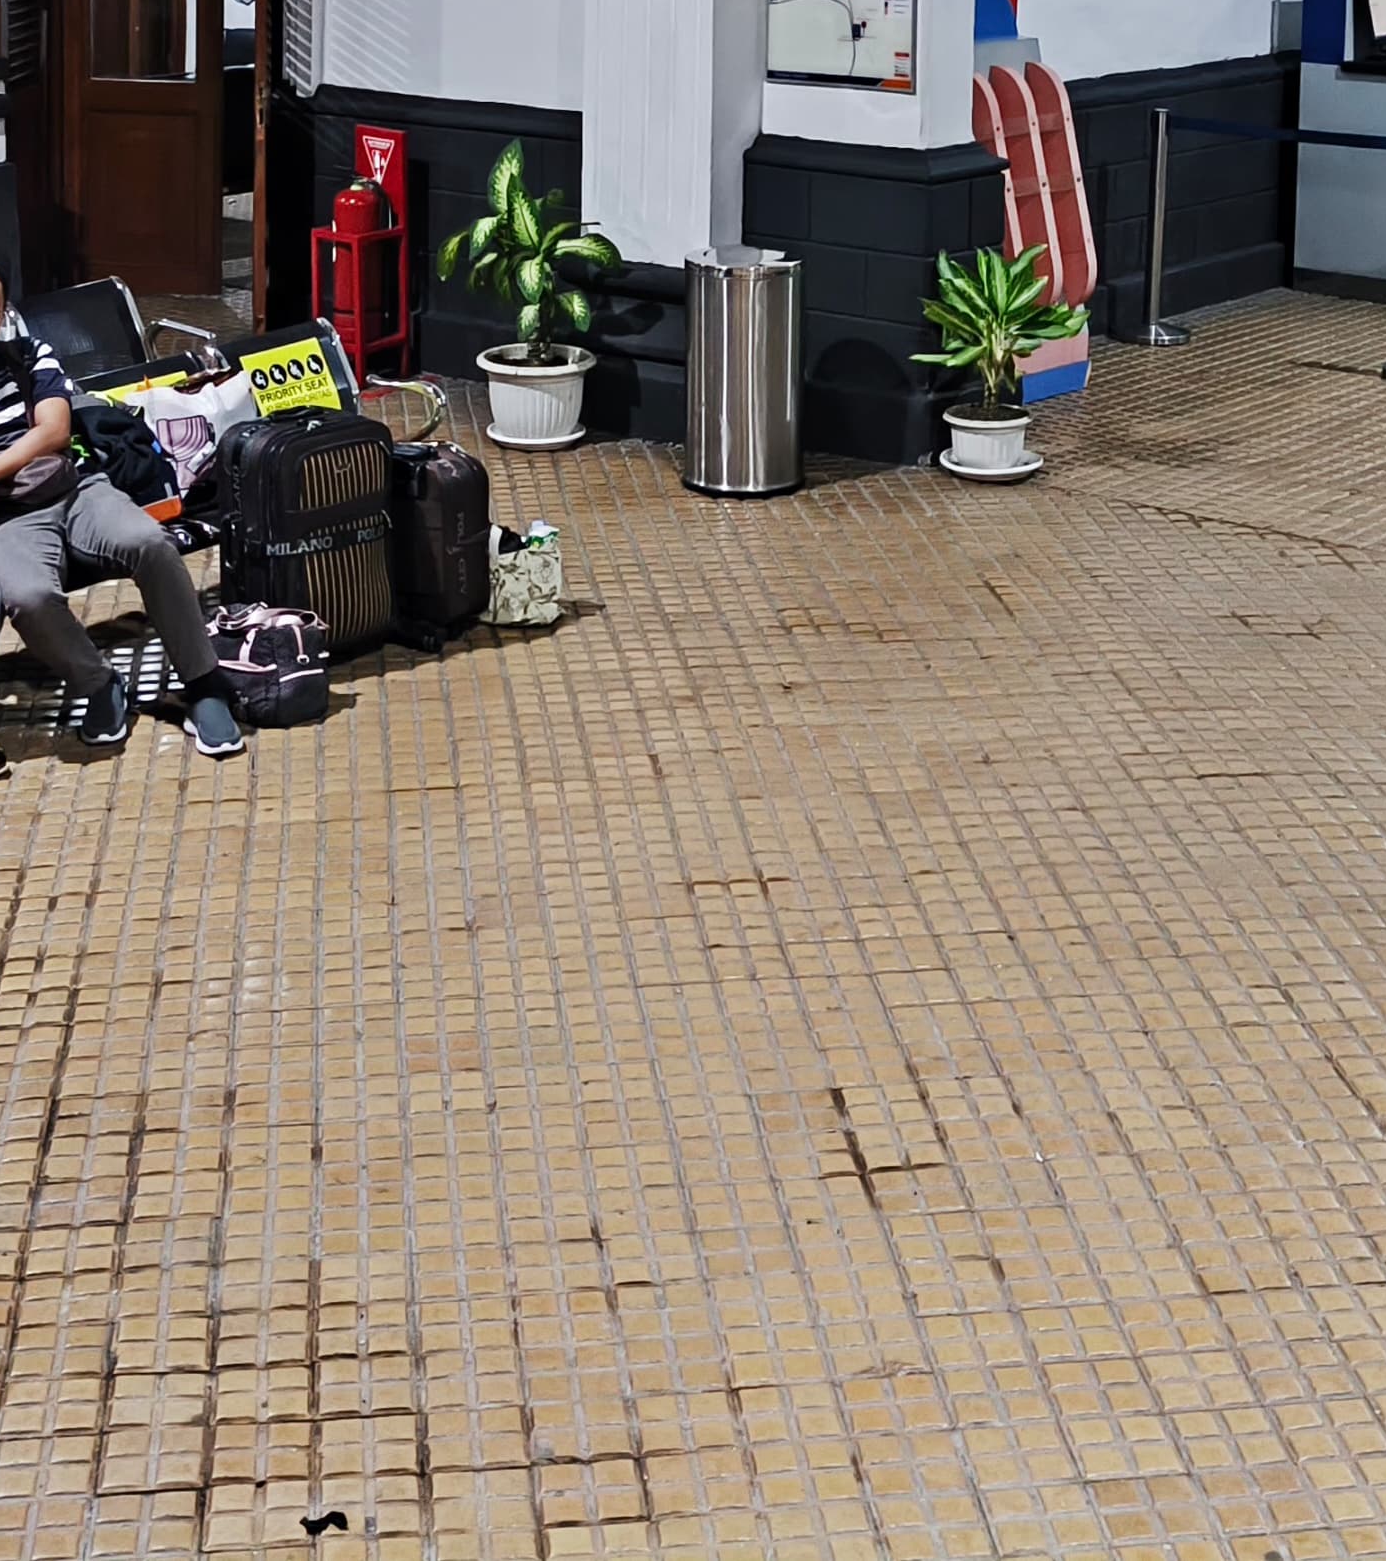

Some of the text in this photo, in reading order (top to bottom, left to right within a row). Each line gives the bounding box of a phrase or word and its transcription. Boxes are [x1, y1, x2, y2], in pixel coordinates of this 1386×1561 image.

[259, 376, 329, 405] PRIORITY SEAT
[266, 525, 385, 557] MILANO POLO
